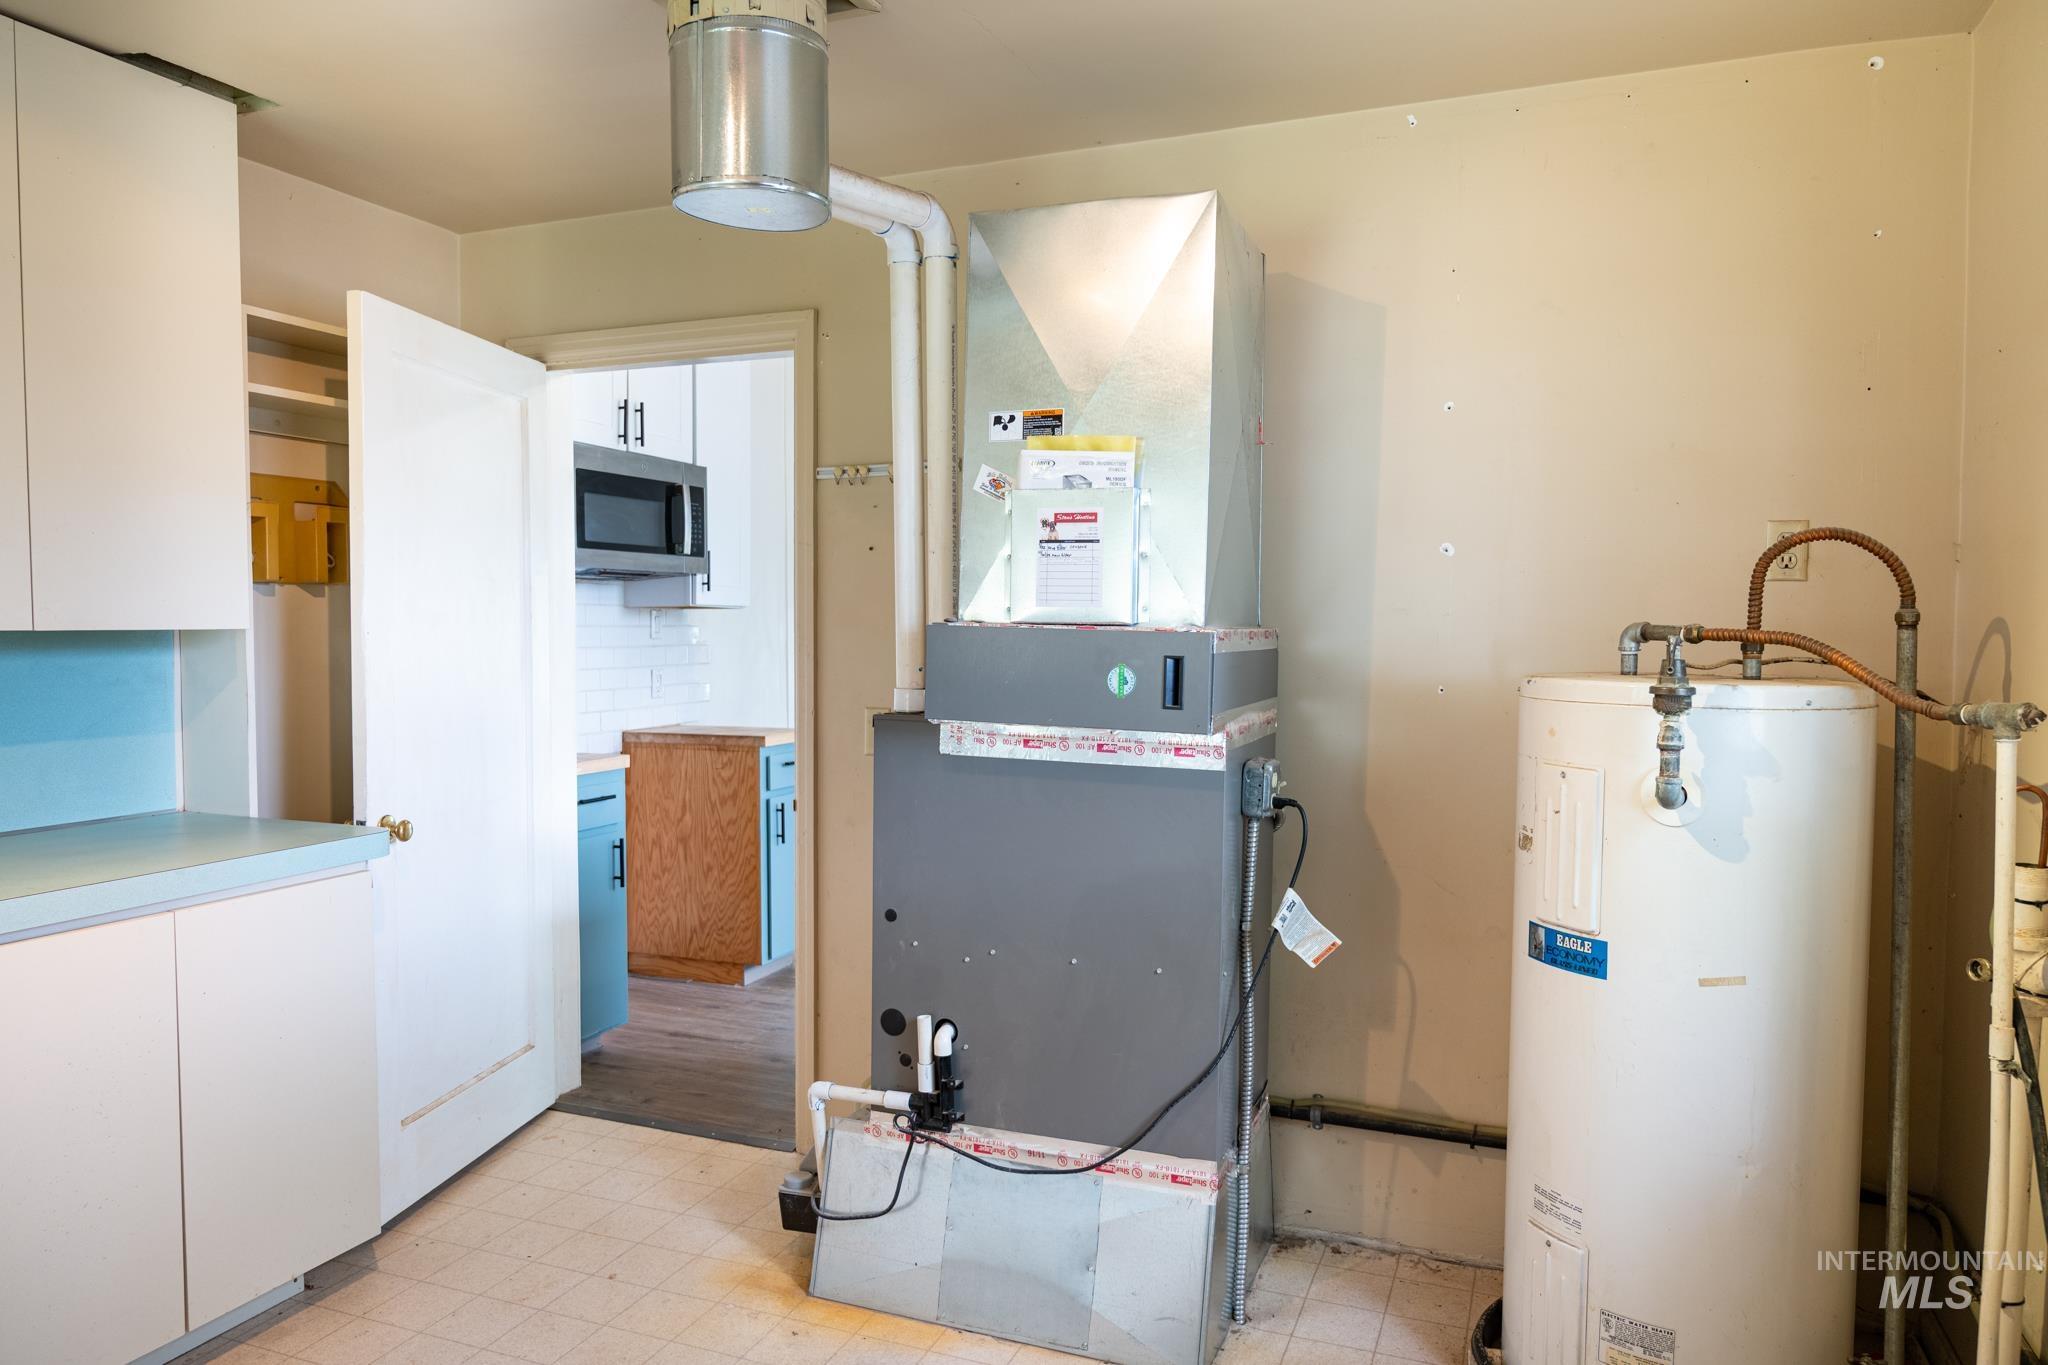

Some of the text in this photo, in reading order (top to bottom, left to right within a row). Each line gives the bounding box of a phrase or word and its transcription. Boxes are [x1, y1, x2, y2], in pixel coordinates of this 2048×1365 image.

[1556, 934, 1592, 954] EAGLE
[1546, 946, 1606, 968] ECONOMY
[1170, 1174, 1207, 1187] Shurtape
